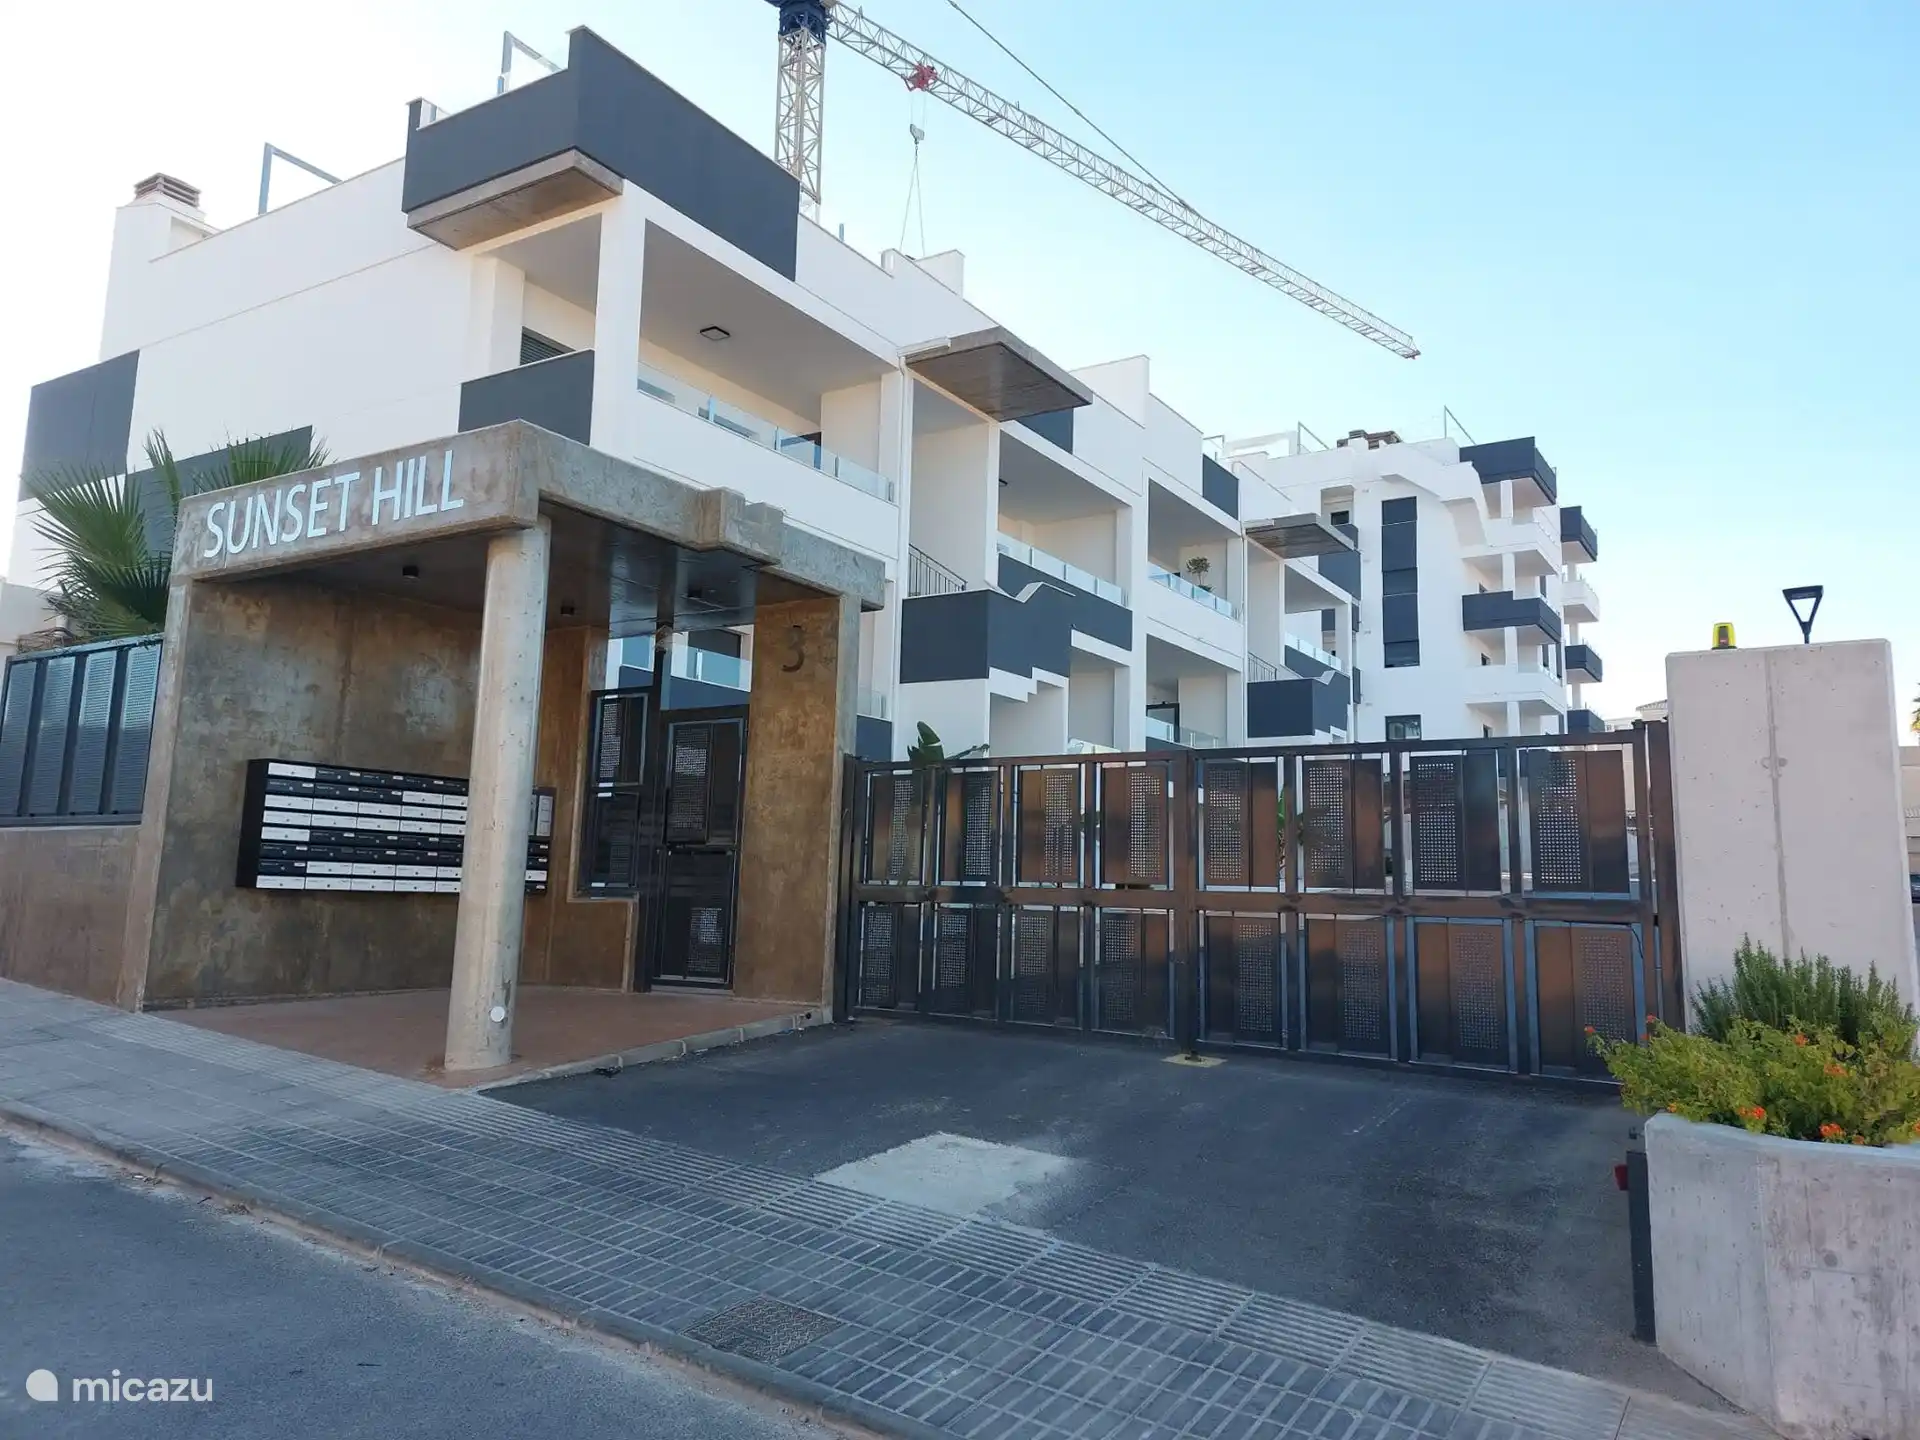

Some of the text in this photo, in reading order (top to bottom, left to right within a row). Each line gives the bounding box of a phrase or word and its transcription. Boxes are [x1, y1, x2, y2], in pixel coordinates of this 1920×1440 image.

[203, 450, 464, 558] SUNSET HILL
[781, 624, 806, 673] 3
